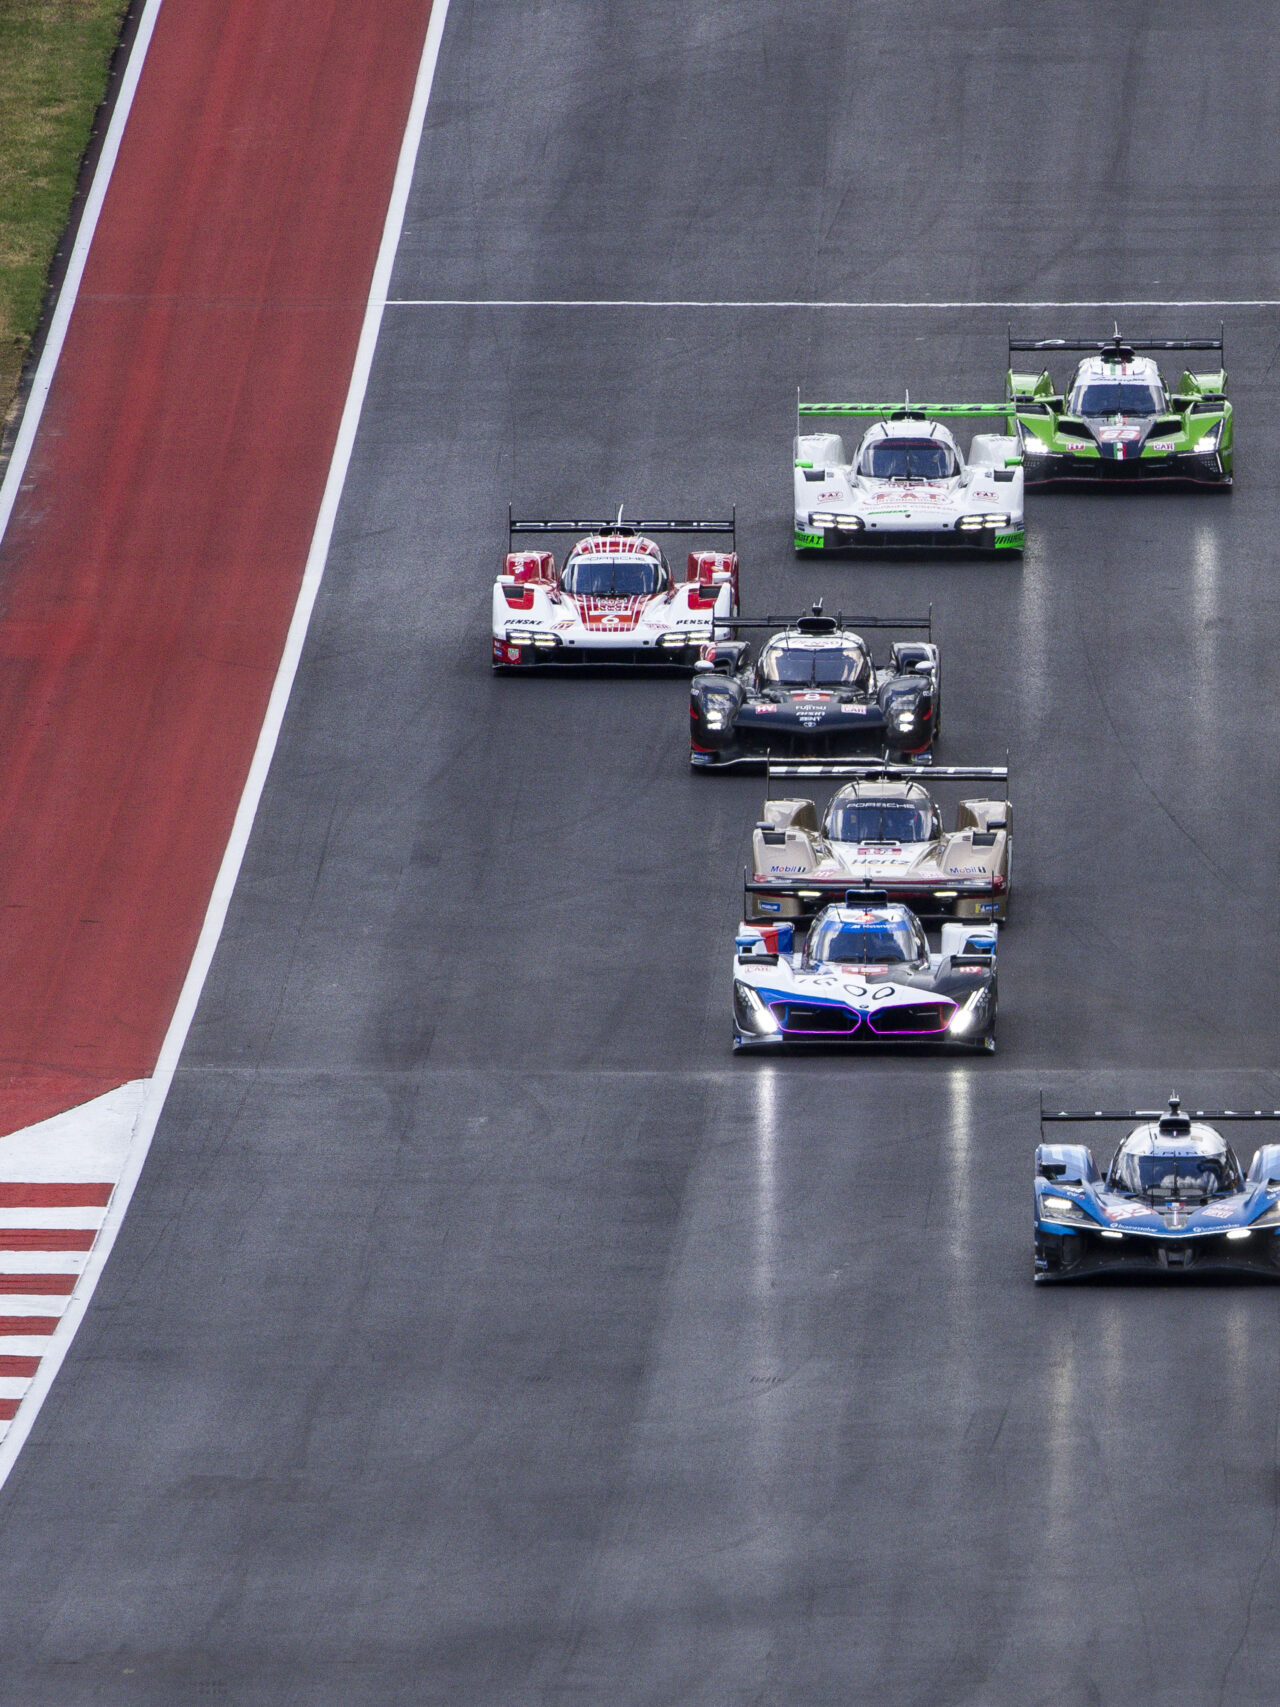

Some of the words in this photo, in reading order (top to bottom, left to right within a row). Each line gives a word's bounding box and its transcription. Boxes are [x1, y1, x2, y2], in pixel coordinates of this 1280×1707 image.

[601, 614, 620, 624] 6
[804, 693, 821, 701] 8
[852, 858, 911, 866] Hertz
[770, 865, 797, 873] Mobil
[949, 866, 977, 874] Mobil
